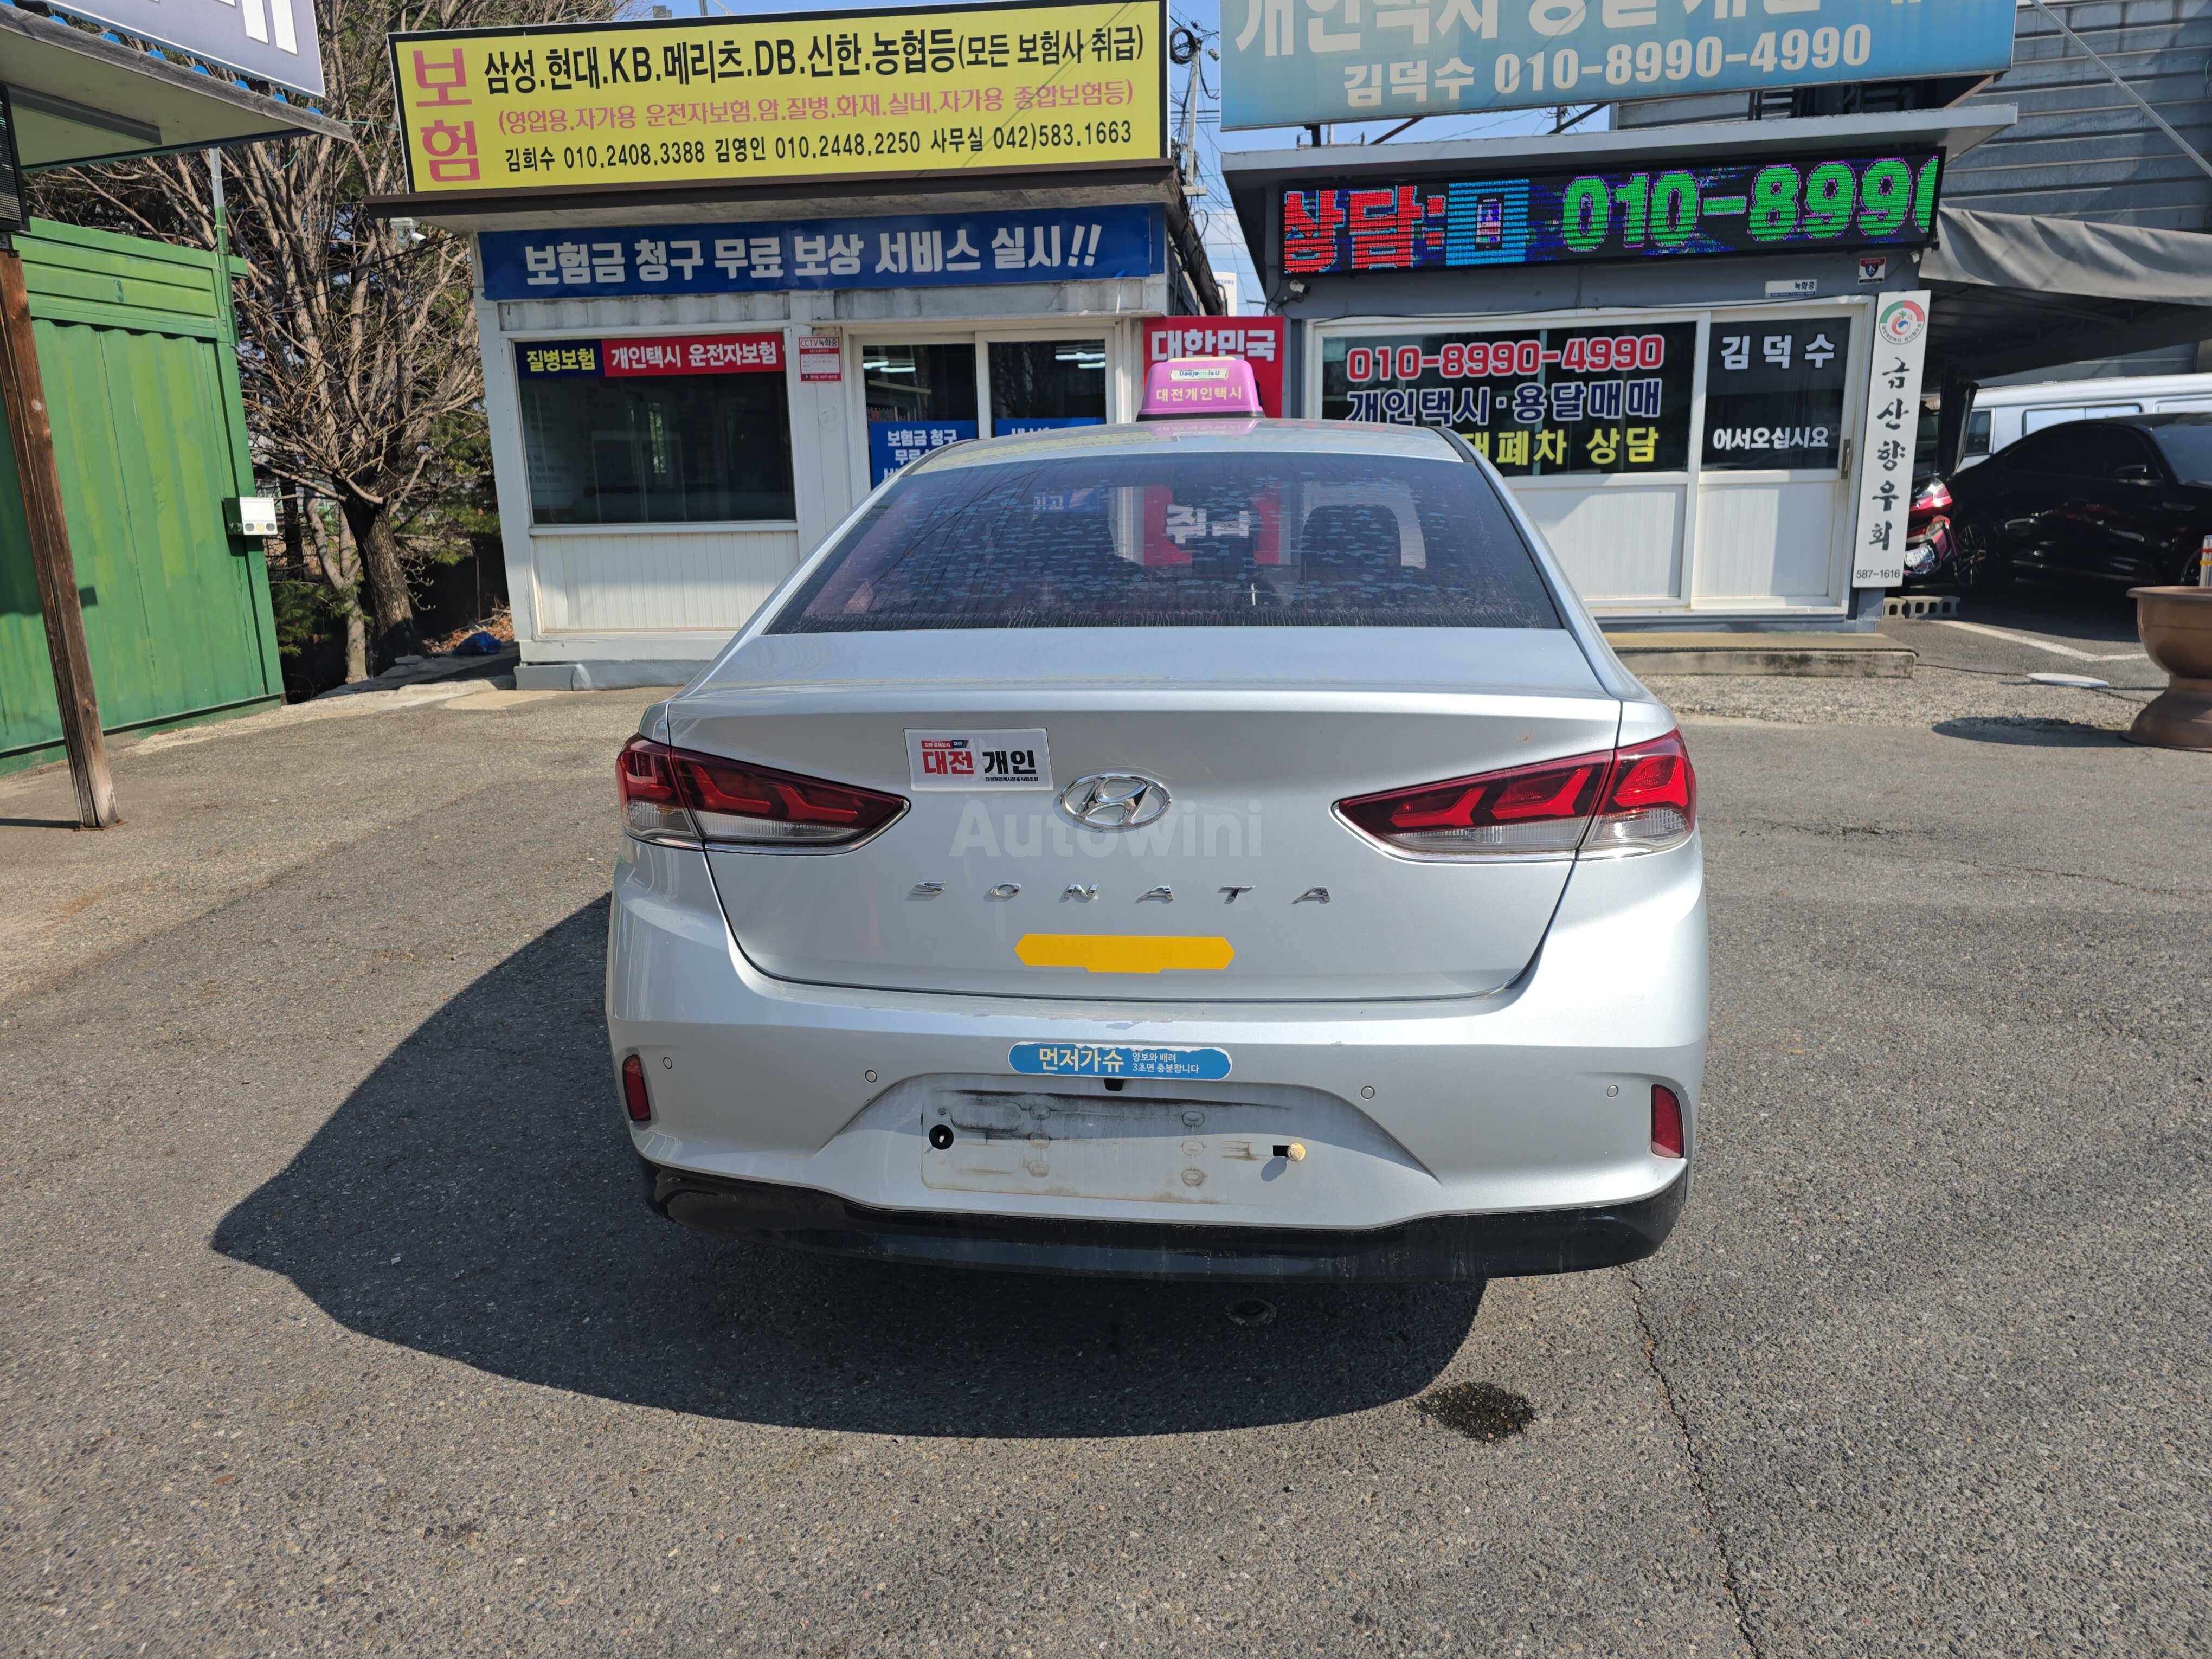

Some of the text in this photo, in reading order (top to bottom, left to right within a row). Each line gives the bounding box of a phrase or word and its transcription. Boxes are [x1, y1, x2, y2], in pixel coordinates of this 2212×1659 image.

[1018, 29, 1084, 65] 보험사
[1091, 24, 1144, 62] 취급)
[1344, 24, 1871, 107] 김덕수 010-8990-4990
[1015, 79, 1134, 107] 종합보험등)
[413, 48, 480, 182] 보험
[505, 120, 1132, 173] 김희수 010.2408.3388 김영인 010.2448.2250 사무실 042)583.1663
[525, 224, 1102, 286] 보험금 청구 무료 보상 서비스 실시!!
[526, 348, 595, 372] 질병보험
[612, 345, 680, 370] 개인택시
[689, 342, 777, 368] 운전자보험
[1151, 329, 1276, 361] 대한민국
[1347, 334, 1664, 381] 010-8990-4990
[1155, 386, 1242, 402] 대전개인택시
[888, 429, 957, 446] 보험금 청구
[1586, 426, 1659, 464] 상담
[1856, 568, 1900, 580] 587-1616
[923, 750, 1037, 774] 대전 개인
[911, 880, 1330, 904] SONATA
[1039, 1047, 1124, 1073] 먼저가슈
[1133, 1053, 1176, 1063] 양보와 배려
[1133, 1063, 1200, 1074] 3초면 충분합니다
